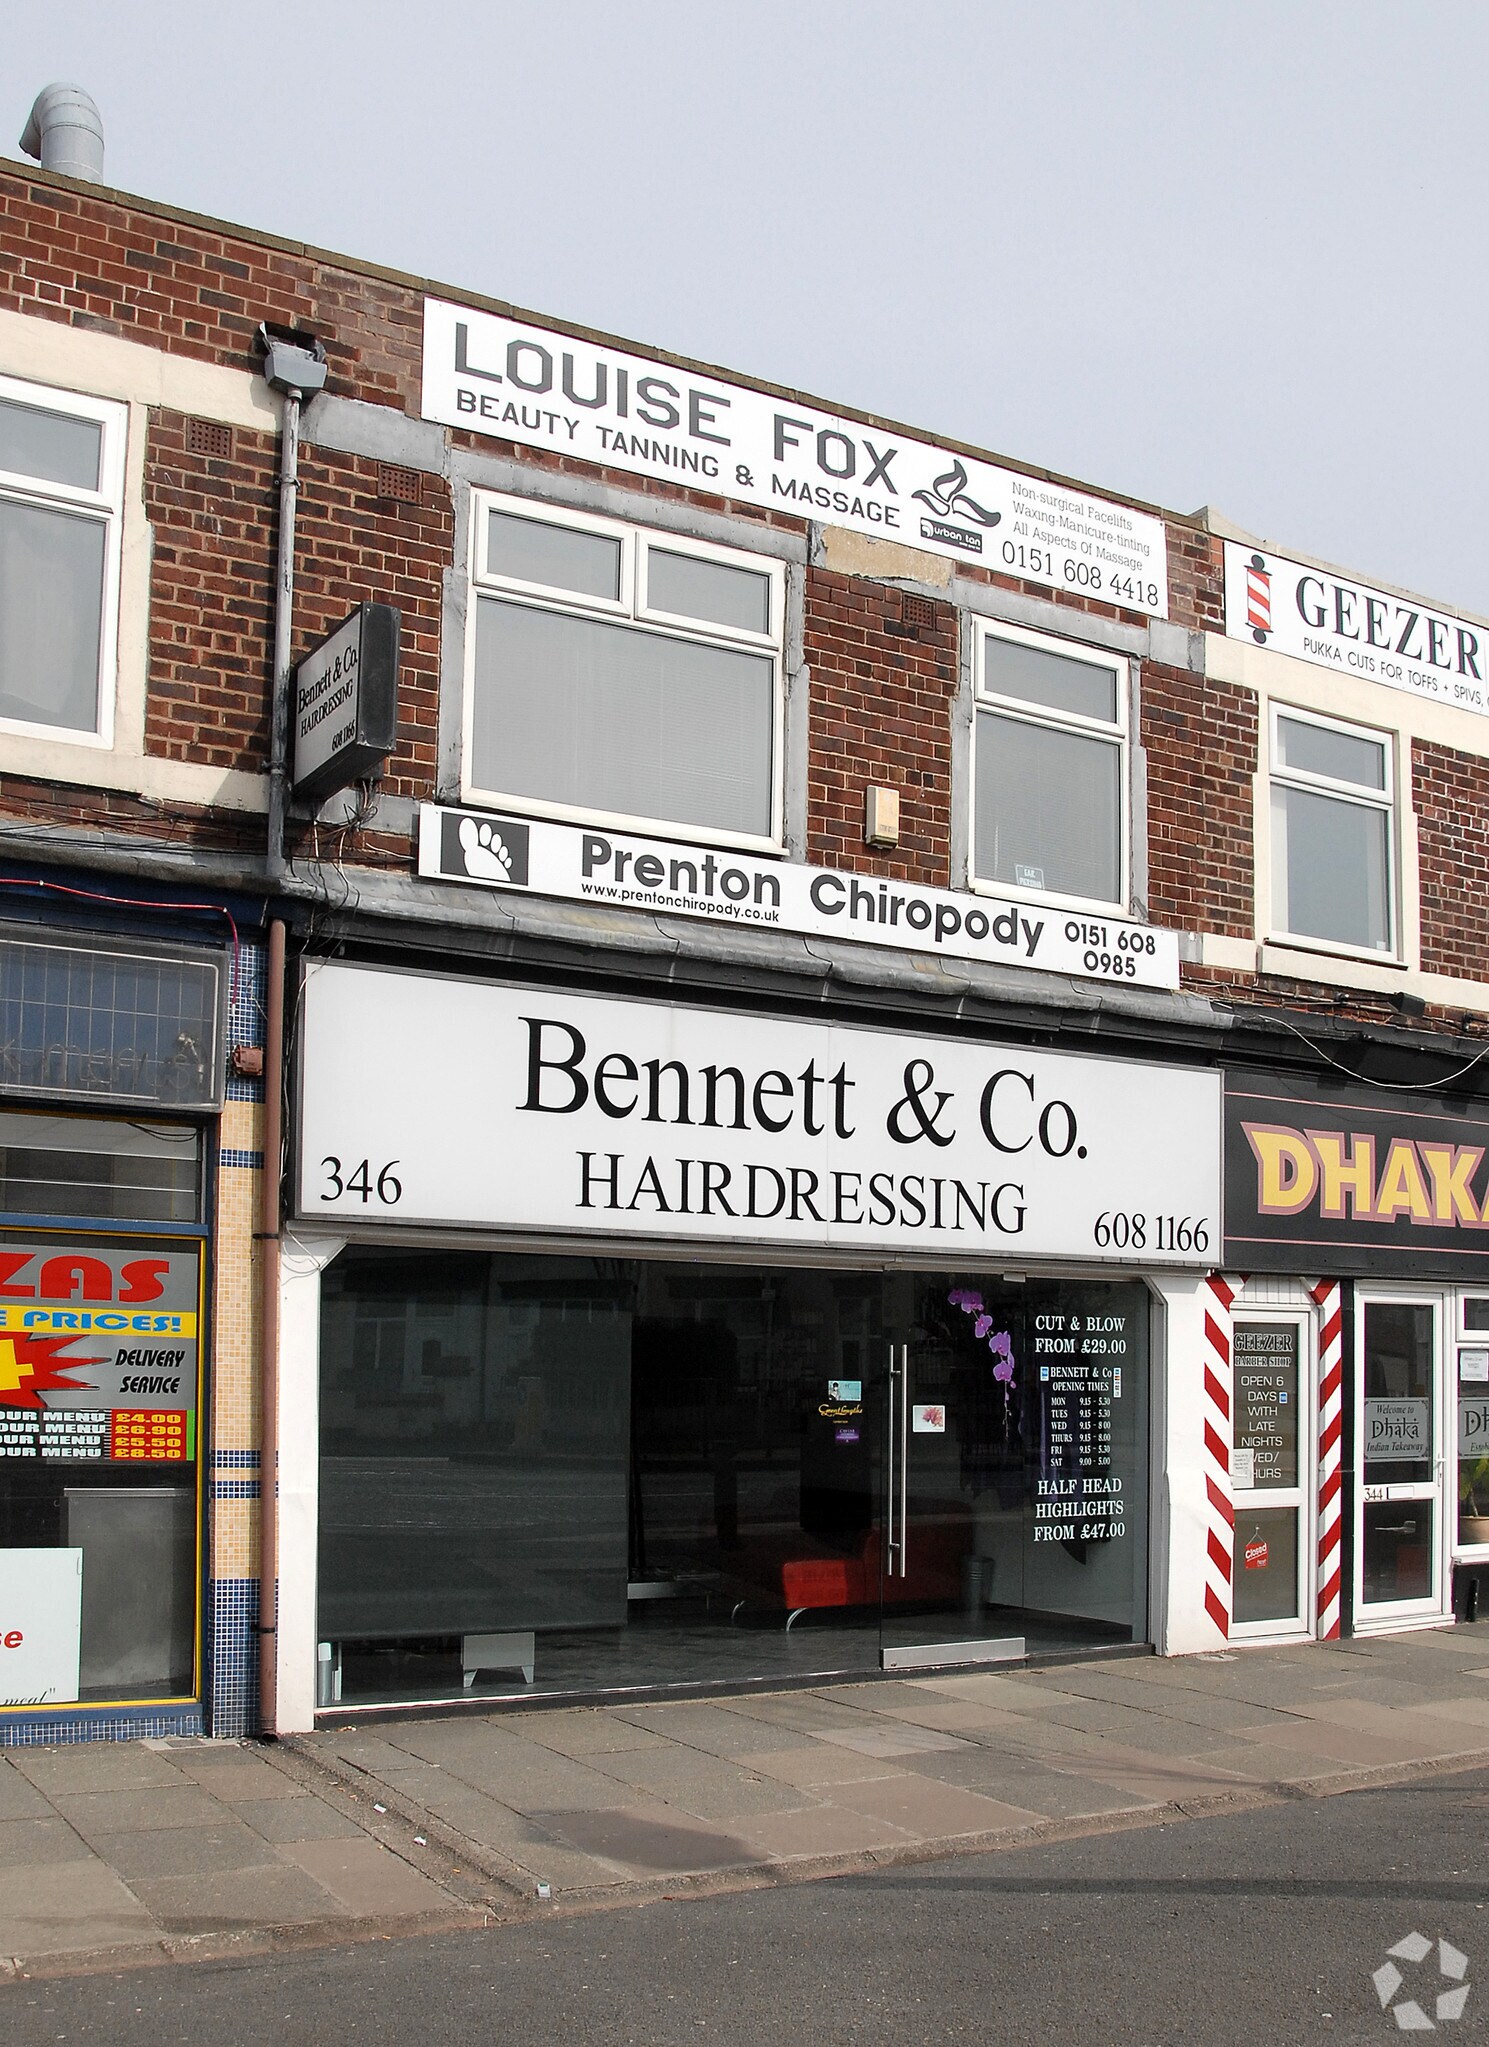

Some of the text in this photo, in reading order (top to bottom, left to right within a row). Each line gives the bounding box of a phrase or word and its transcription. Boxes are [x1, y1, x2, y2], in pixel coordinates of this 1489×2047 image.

[455, 322, 898, 495] LOUISE FOX
[457, 389, 900, 528] BEAUTY TANNING & MASSAGE
[1012, 481, 1133, 531] Non-surgical Facelifts
[934, 527, 962, 541] urban
[965, 534, 981, 546] tan
[1013, 521, 1143, 571] All Aspects Of Massage
[1002, 540, 1158, 607] 0151 608 4418
[1296, 576, 1482, 680] GEEZER
[1304, 637, 1342, 662] PUKKA
[1348, 651, 1375, 672] CUTS
[1381, 661, 1402, 681] FOR
[1408, 669, 1438, 691] TOFFS
[1454, 684, 1484, 707] SPIVS,
[298, 666, 331, 715] Bennett
[333, 656, 342, 683] &
[301, 679, 354, 738] HAIRDRESSING
[582, 834, 1044, 957] Prenton Chiropody
[582, 882, 780, 923] www.prentonchiropody.co.uk
[1064, 921, 1156, 956] 0151 608
[1083, 950, 1136, 978] 0985
[515, 1016, 1088, 1159] Bennett & Co.
[320, 1156, 403, 1205] 346
[1240, 1121, 1489, 1230] DHAK
[575, 1151, 1028, 1234] HAIRDRESSING
[1093, 1211, 1209, 1252] 608 1166
[23, 1310, 182, 1333] PRICES!
[1035, 1315, 1126, 1332] CUT & BLOW
[1034, 1338, 1127, 1354] FROM £29.00
[1233, 1333, 1293, 1352] GEEZER
[115, 1348, 186, 1368] DELIVERY
[1234, 1355, 1292, 1368] BARBER SHOP
[1050, 1366, 1113, 1378] BENNETT & Co
[1240, 1376, 1284, 1386] OPEN 6
[119, 1376, 181, 1394] SERVICE
[1052, 1382, 1110, 1392] OPENING TIMES
[1051, 1397, 1066, 1406] MON
[1247, 1391, 1277, 1401] DAYS
[43, 1411, 106, 1423] MENU
[116, 1413, 181, 1424] £4.00
[1051, 1409, 1068, 1419] TUES
[1247, 1406, 1278, 1416] WITH
[1376, 1404, 1406, 1414] Welcome
[45, 1423, 106, 1434] MENU
[115, 1425, 182, 1435] £6.90
[1051, 1421, 1068, 1430] WED
[1249, 1421, 1276, 1431] LATE
[1371, 1417, 1420, 1439] Dhaka
[0, 1434, 181, 1448] UR MENU £5.50
[1051, 1433, 1073, 1442] THURS
[1241, 1436, 1283, 1447] NIGHTS
[41, 1447, 102, 1458] MENU
[114, 1448, 181, 1459] £8.50
[1051, 1445, 1063, 1454] FRI
[1366, 1442, 1390, 1452] Indian
[1051, 1457, 1063, 1466] SAT
[1037, 1478, 1122, 1496] HALF HEAD
[1364, 1487, 1384, 1501] 344
[1035, 1500, 1124, 1519] HIGHLIGHTS
[1033, 1522, 1126, 1542] FROM £47.00
[1245, 1542, 1268, 1559] Closed
